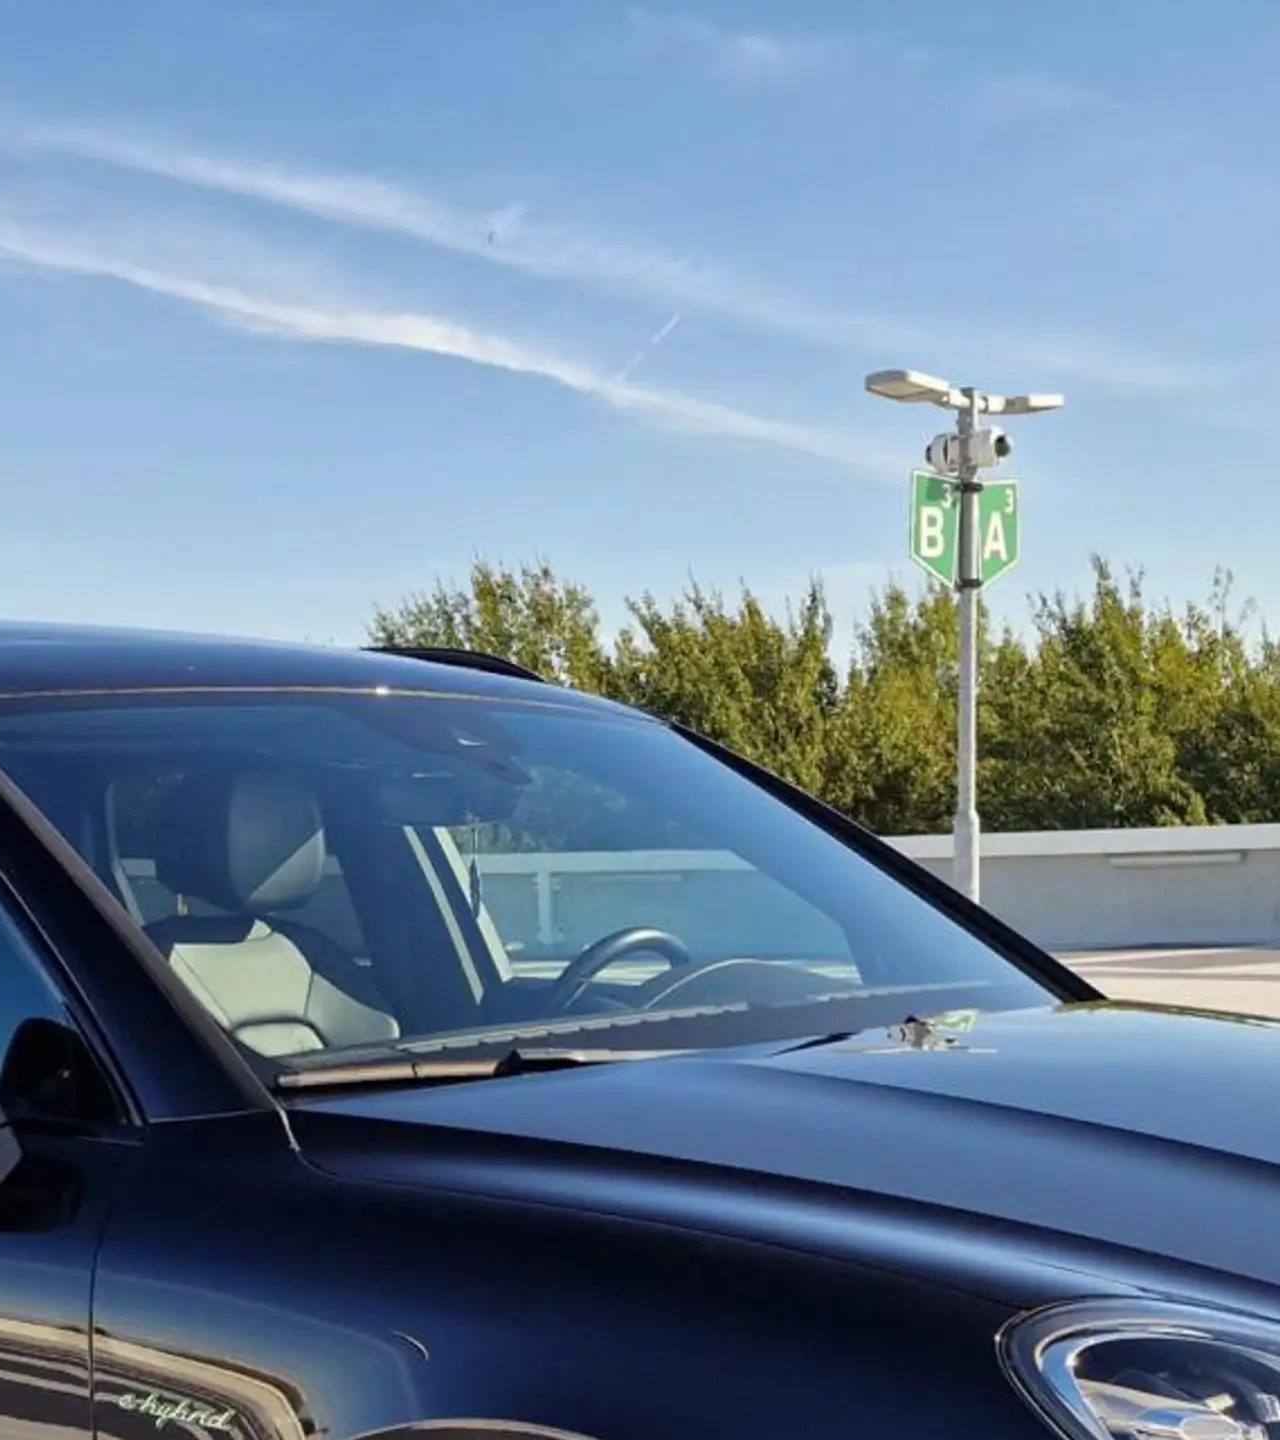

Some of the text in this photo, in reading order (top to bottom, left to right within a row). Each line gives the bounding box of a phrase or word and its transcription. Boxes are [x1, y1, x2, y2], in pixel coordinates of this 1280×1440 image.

[1004, 488, 1014, 514] 3
[920, 505, 945, 557] B
[982, 510, 1008, 560] A
